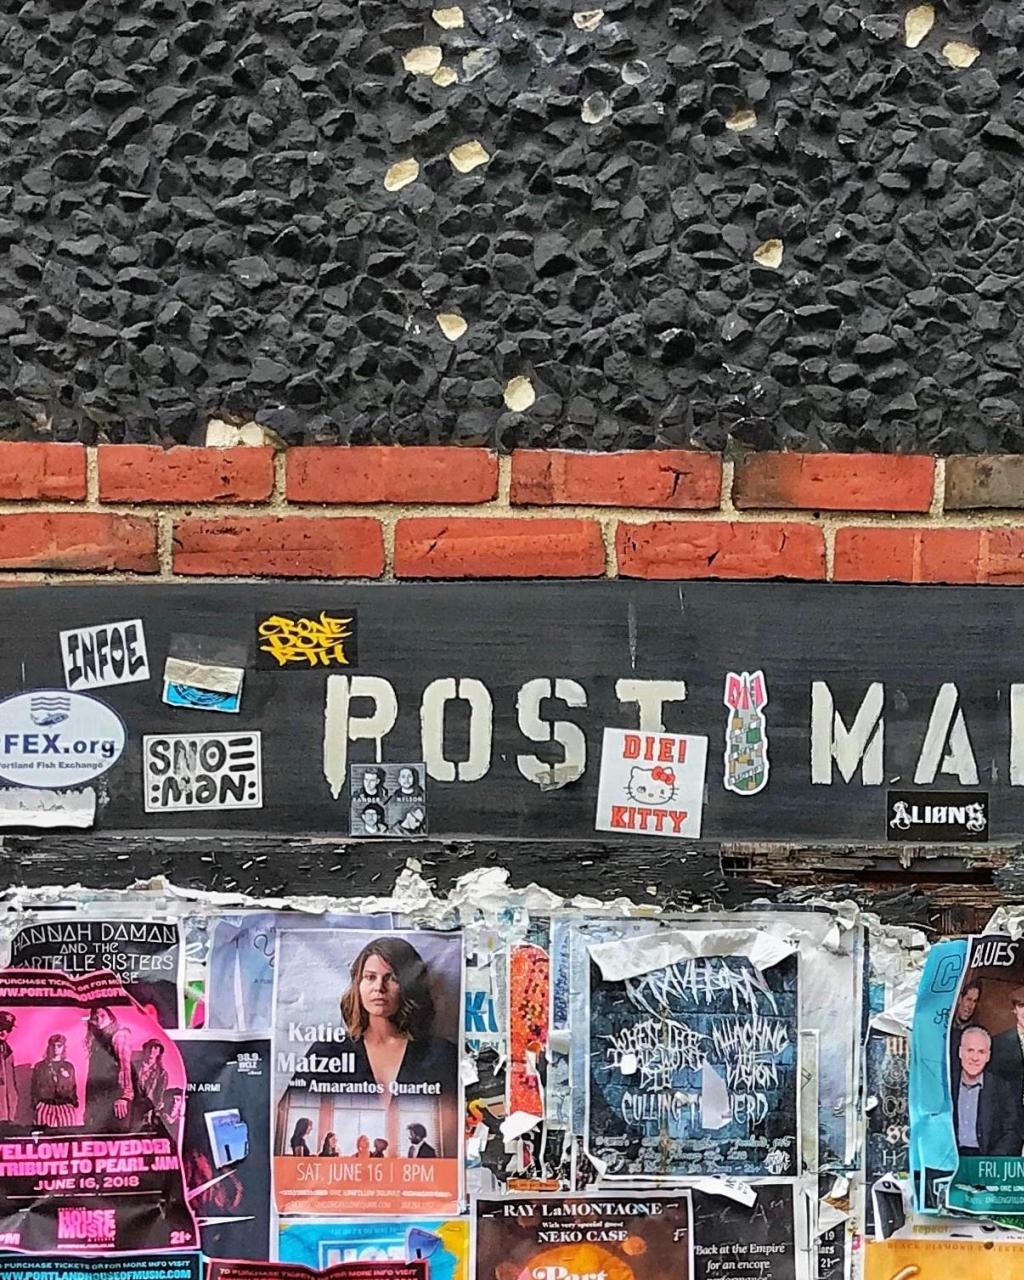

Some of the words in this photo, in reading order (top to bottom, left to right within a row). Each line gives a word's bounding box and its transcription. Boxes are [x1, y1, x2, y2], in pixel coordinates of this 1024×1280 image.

[324, 673, 686, 798] POST
[623, 734, 688, 764] DIE!
[610, 805, 688, 833] KITTY
[13, 923, 92, 952] HANNAH
[101, 923, 177, 944] DAMAN
[971, 942, 1019, 968] BLUES
[289, 1022, 347, 1044] Katie
[277, 1053, 355, 1074] Matzell
[72, 1139, 171, 1157] LEDVEDDER
[70, 1159, 90, 1173] TO
[94, 1157, 148, 1173] PEARL
[151, 1155, 179, 1172] JAM
[978, 1161, 1000, 1179] FRI.
[33, 1178, 76, 1191] JUNE
[79, 1177, 100, 1191] 16,
[103, 1176, 140, 1188] 2018
[296, 1164, 324, 1182] SAT.
[328, 1164, 363, 1186] JUNE
[367, 1165, 383, 1182] 16
[402, 1165, 435, 1183] 8PM
[503, 1204, 537, 1217] RAY
[537, 1230, 583, 1243] NEKO
[586, 1230, 628, 1242] CASE
